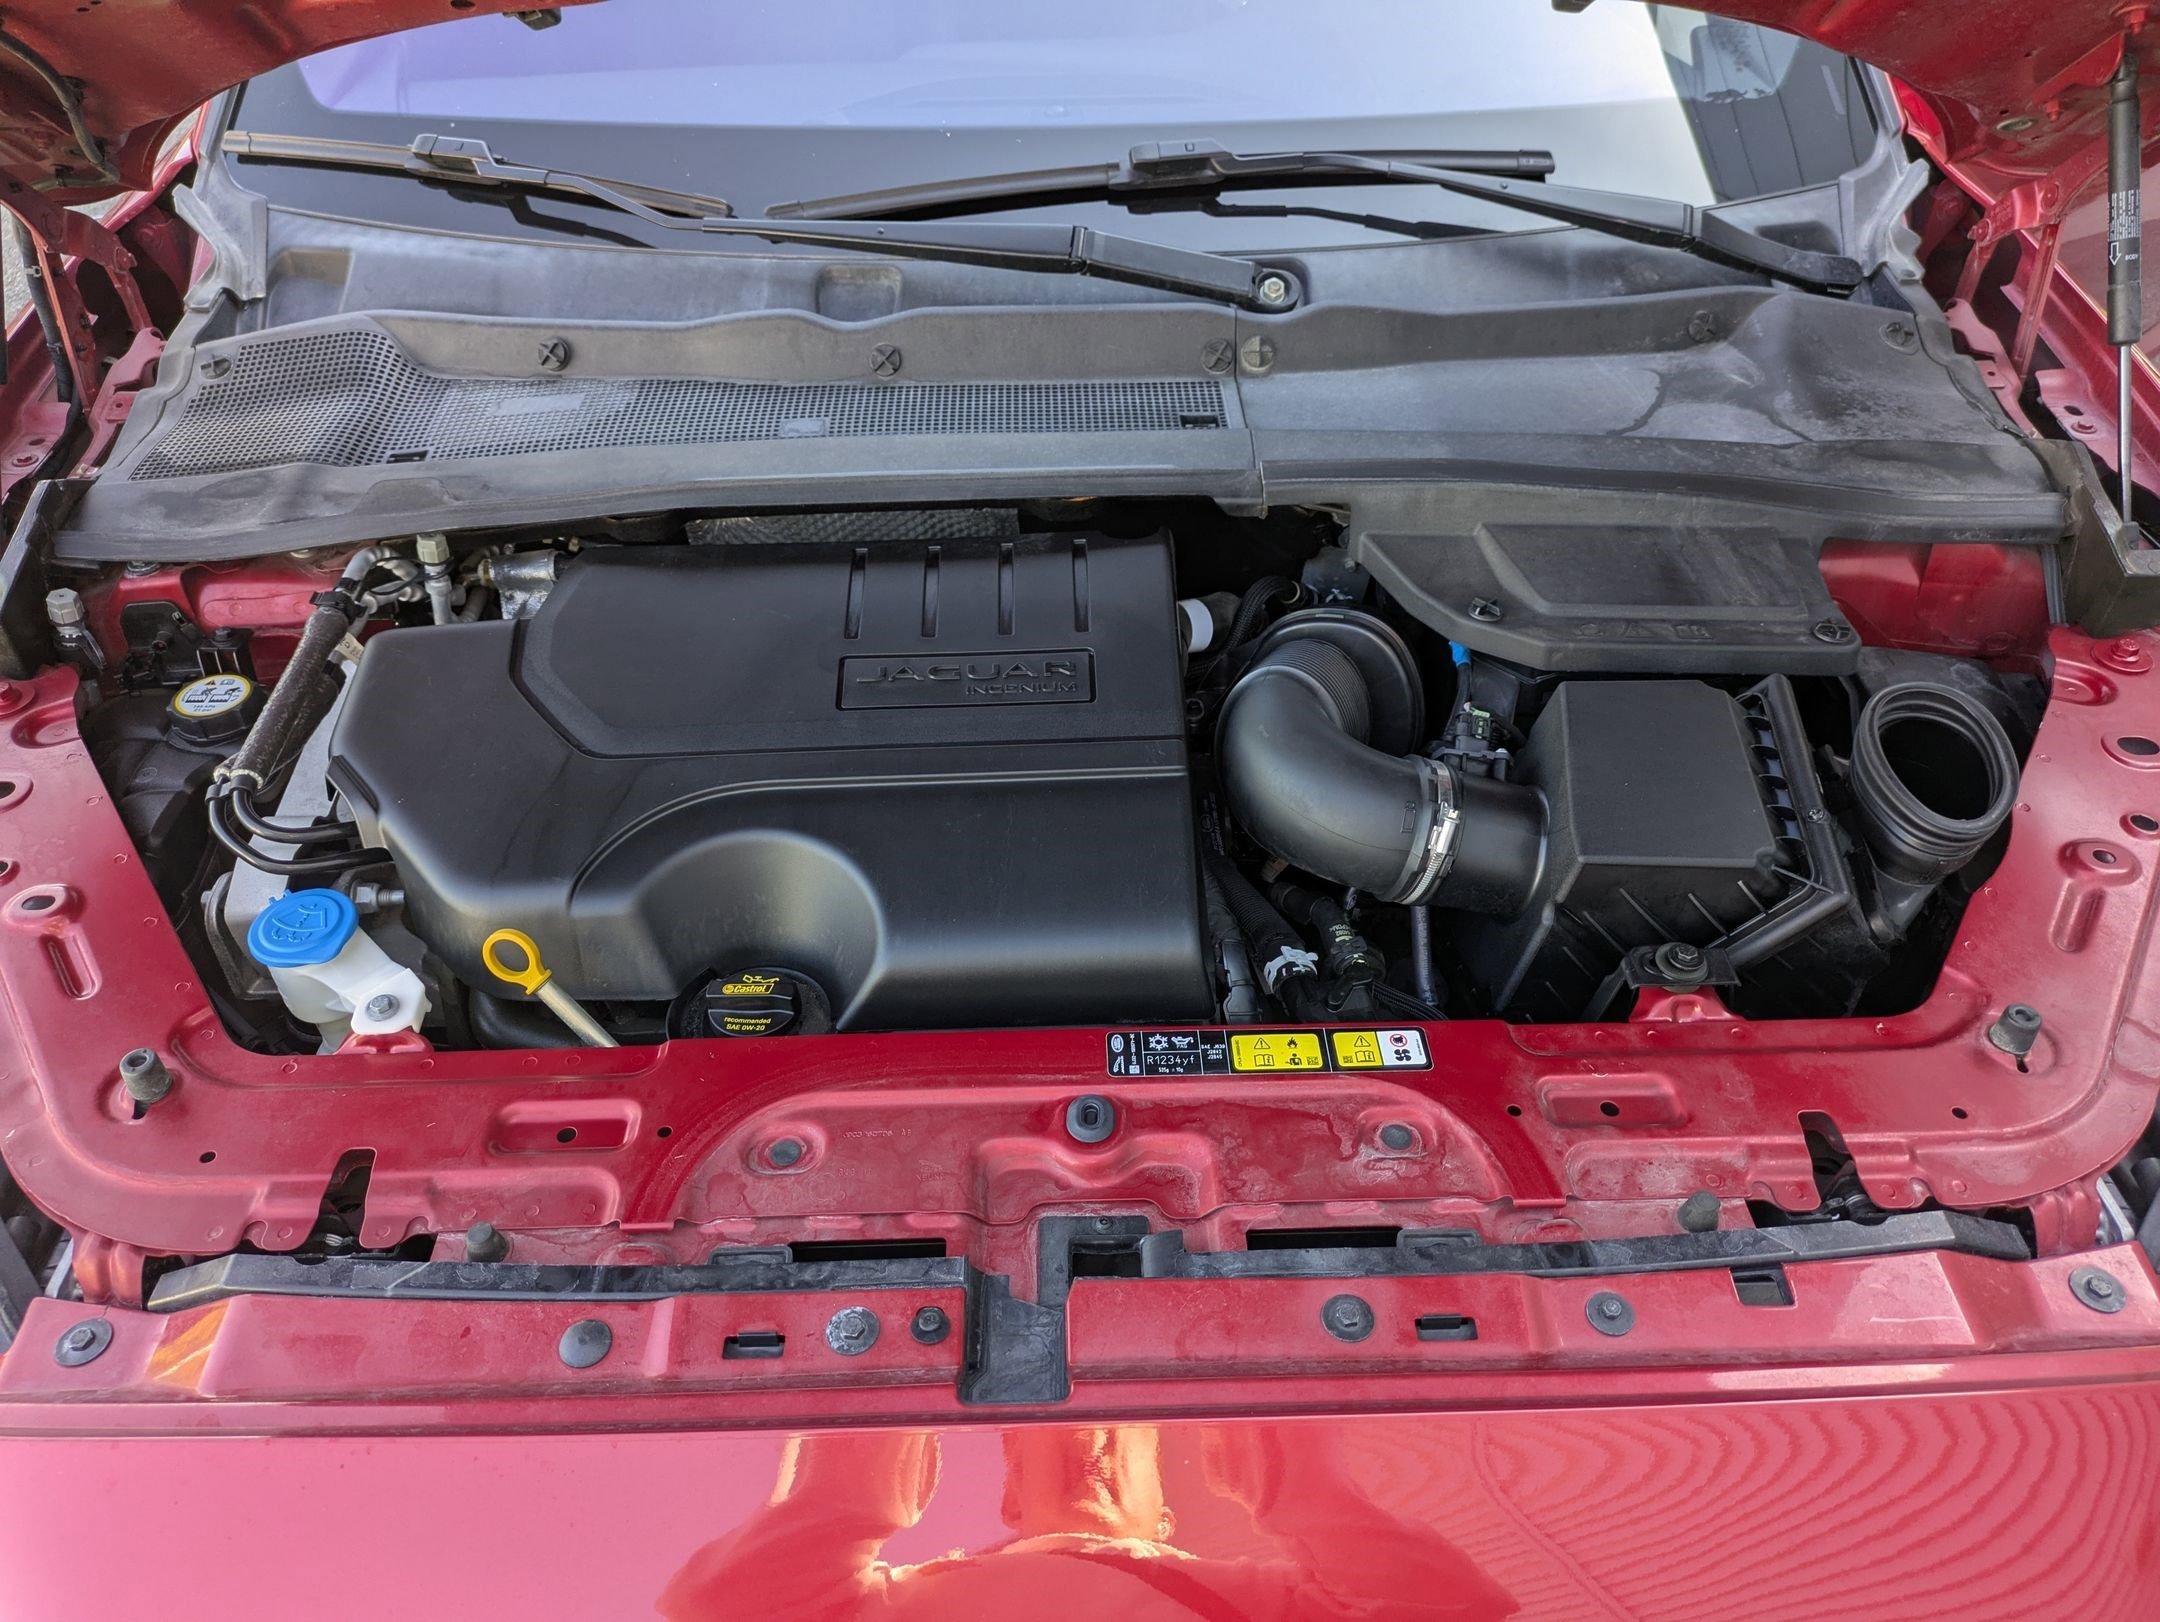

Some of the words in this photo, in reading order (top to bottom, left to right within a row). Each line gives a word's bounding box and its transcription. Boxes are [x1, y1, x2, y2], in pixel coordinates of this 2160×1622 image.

[856, 661, 1076, 682] JAGUAR
[966, 682, 1076, 695] INGENIUM
[733, 984, 766, 993] Castrol
[723, 1016, 772, 1024] recommended
[1146, 1055, 1195, 1066] R1234yf
